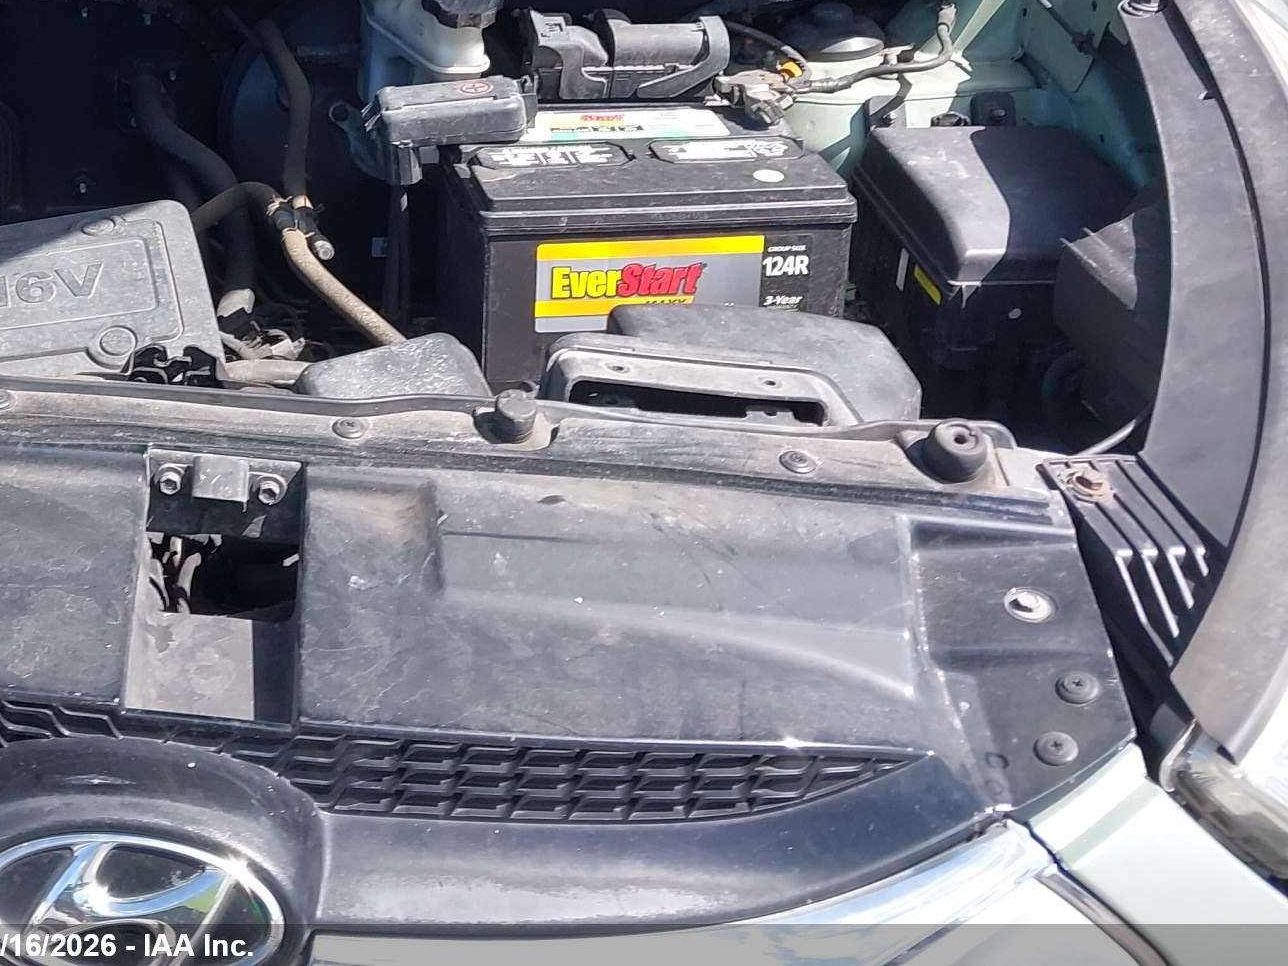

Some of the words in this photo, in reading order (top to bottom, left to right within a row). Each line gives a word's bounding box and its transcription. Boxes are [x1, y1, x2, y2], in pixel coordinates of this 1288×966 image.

[762, 255, 810, 277] 124R
[550, 262, 703, 300] EverStart
[762, 295, 804, 306] 3-Year
